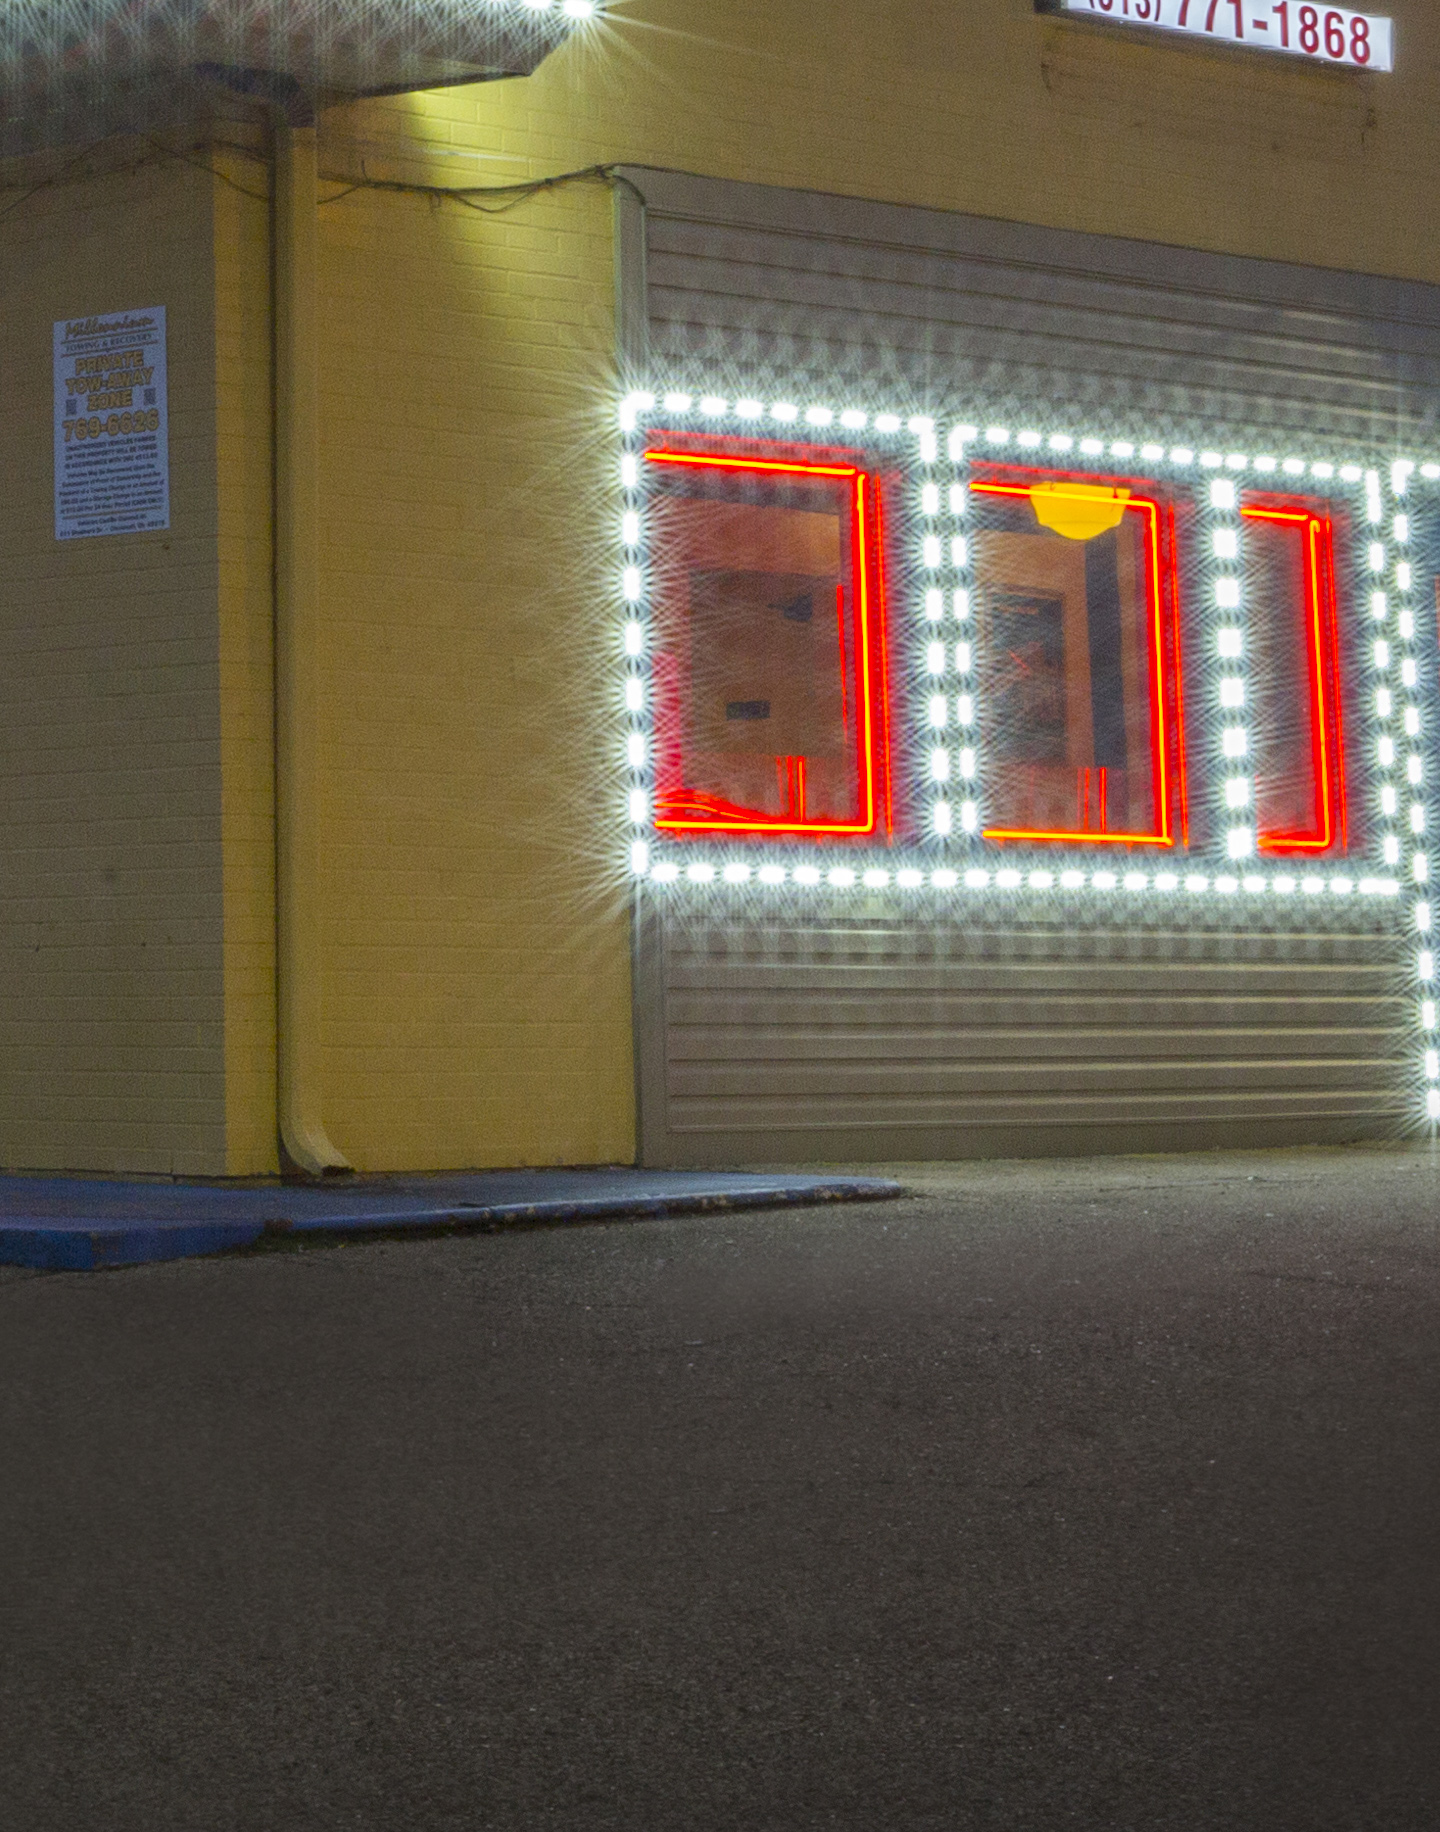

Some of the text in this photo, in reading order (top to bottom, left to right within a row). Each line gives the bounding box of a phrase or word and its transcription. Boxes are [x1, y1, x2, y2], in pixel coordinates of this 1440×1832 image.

[75, 349, 144, 376] PRIVATE
[65, 366, 155, 396] TOW-AWAY
[87, 388, 133, 412] ZONE
[62, 408, 160, 442] 769-6626
